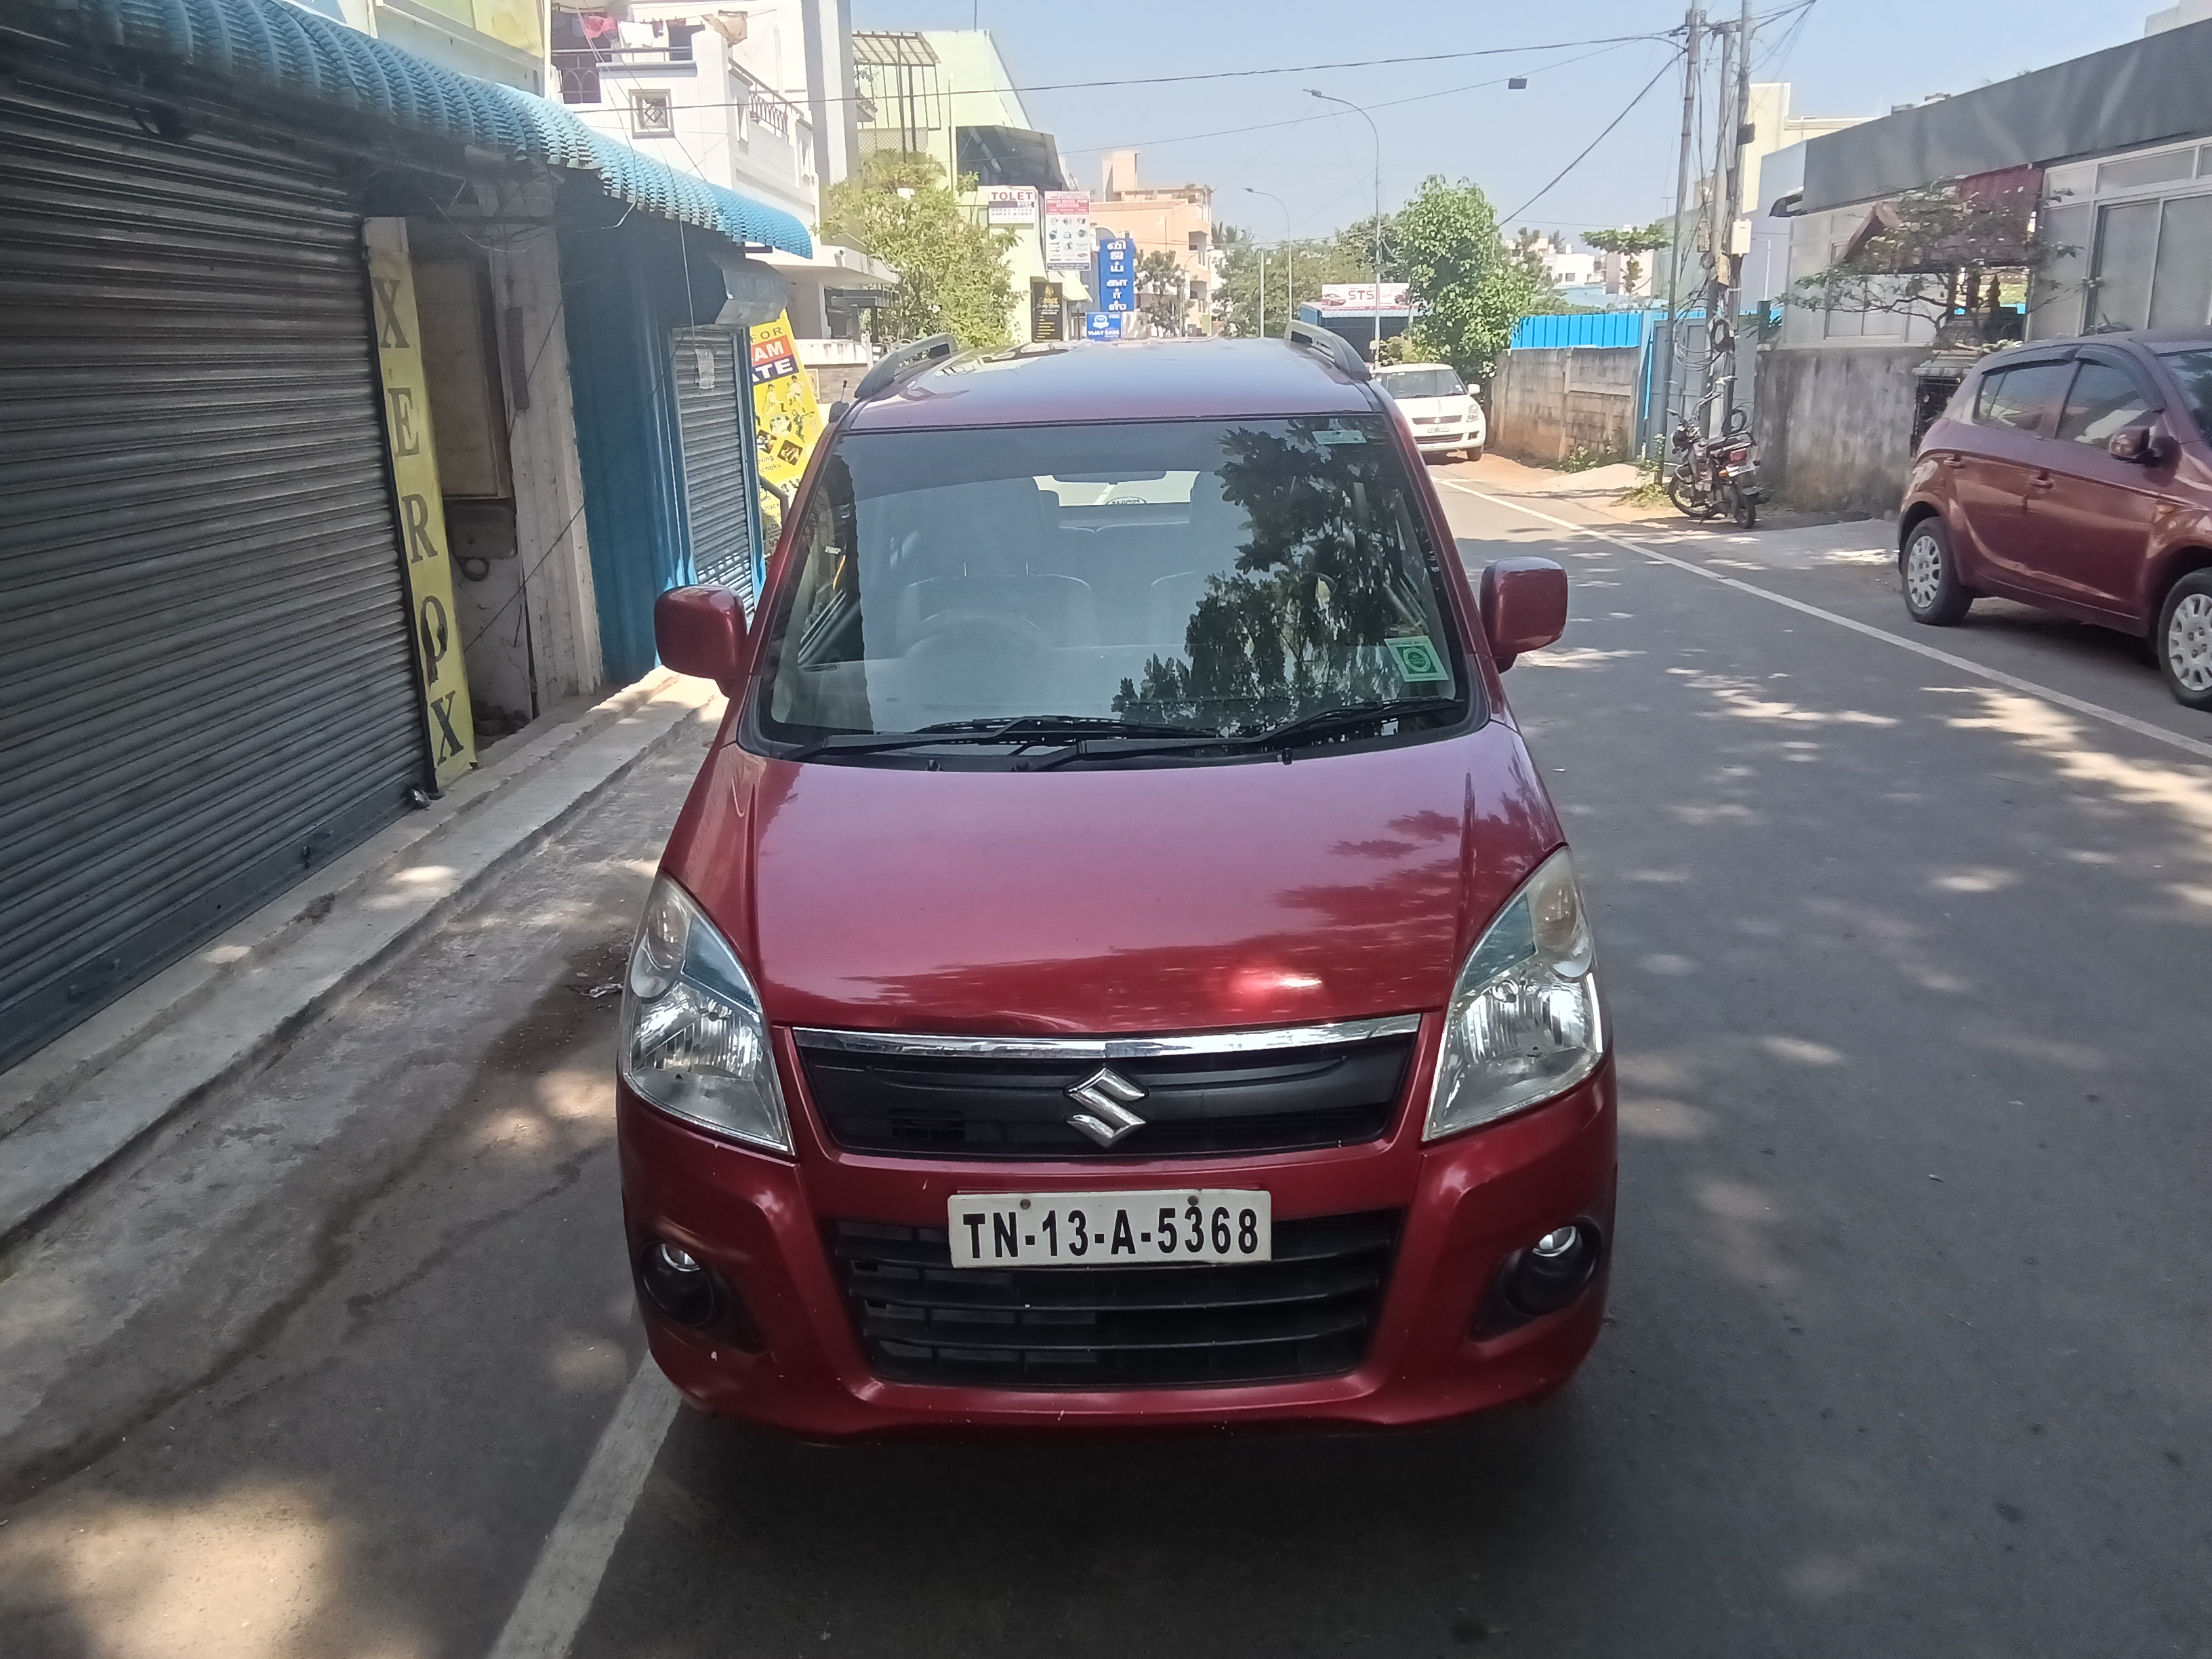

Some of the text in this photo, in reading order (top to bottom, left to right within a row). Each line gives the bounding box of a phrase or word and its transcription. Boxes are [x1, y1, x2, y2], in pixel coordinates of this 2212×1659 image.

[991, 192, 1033, 201] TOLET
[1349, 290, 1374, 300] STS
[752, 340, 785, 363] AM
[373, 275, 464, 766] XEROX
[962, 1206, 1258, 1259] TN-13-A-5368
